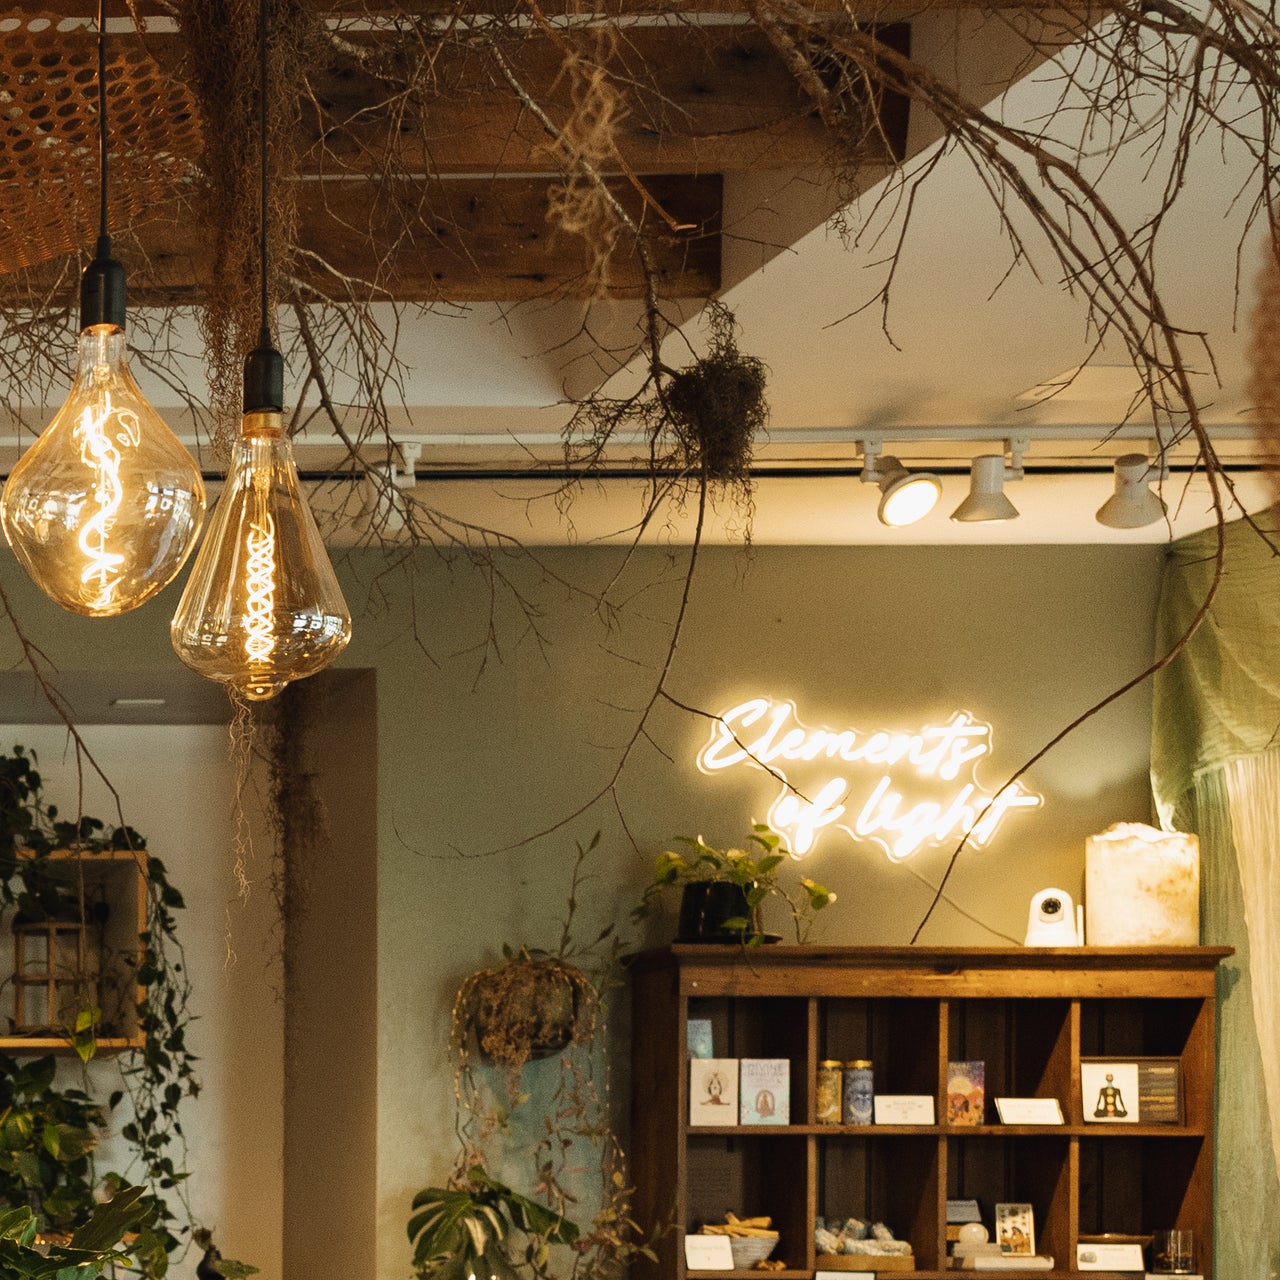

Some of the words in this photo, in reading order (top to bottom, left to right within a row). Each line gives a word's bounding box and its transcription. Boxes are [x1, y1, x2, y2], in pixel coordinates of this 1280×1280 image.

[703, 697, 989, 781] Elements
[773, 776, 846, 855] of
[856, 775, 1040, 858] light
